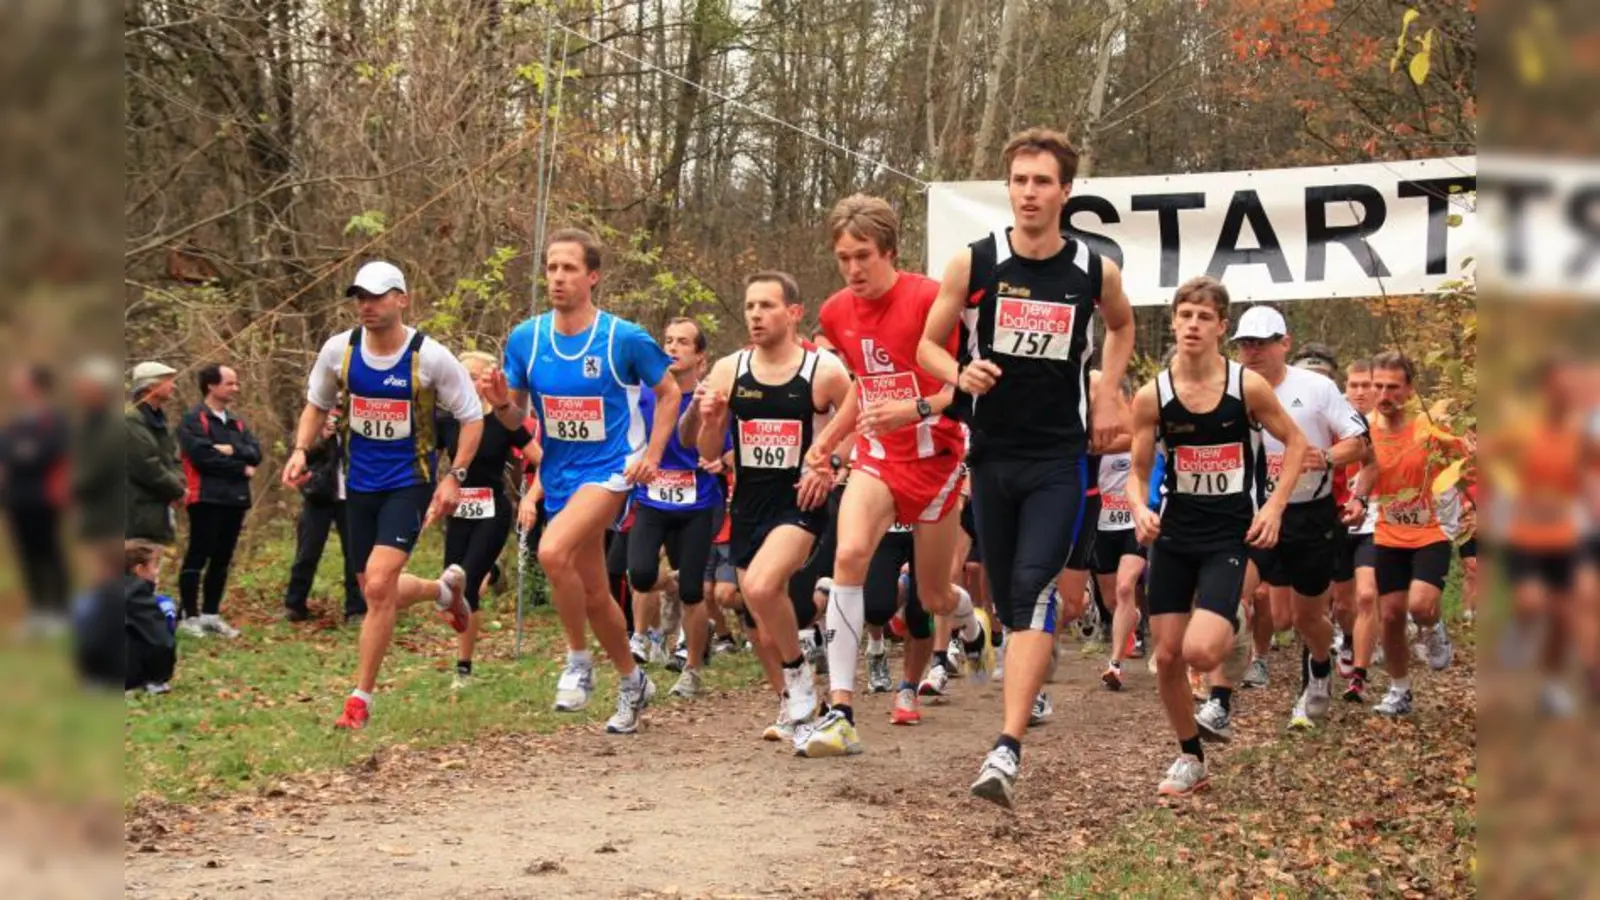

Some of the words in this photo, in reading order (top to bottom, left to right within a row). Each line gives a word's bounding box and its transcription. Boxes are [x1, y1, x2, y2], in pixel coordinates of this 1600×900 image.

[1060, 176, 1477, 288] START
[1021, 303, 1052, 316] new
[1003, 313, 1066, 332] balance
[1011, 331, 1053, 355] 757
[363, 420, 394, 438] 816
[557, 421, 589, 439] 836
[744, 431, 796, 445] balance
[753, 446, 785, 466] 969
[1180, 459, 1237, 471] balance
[1192, 472, 1228, 493] 710
[660, 487, 684, 502] 615
[460, 503, 484, 517] 856
[1109, 511, 1131, 523] 698
